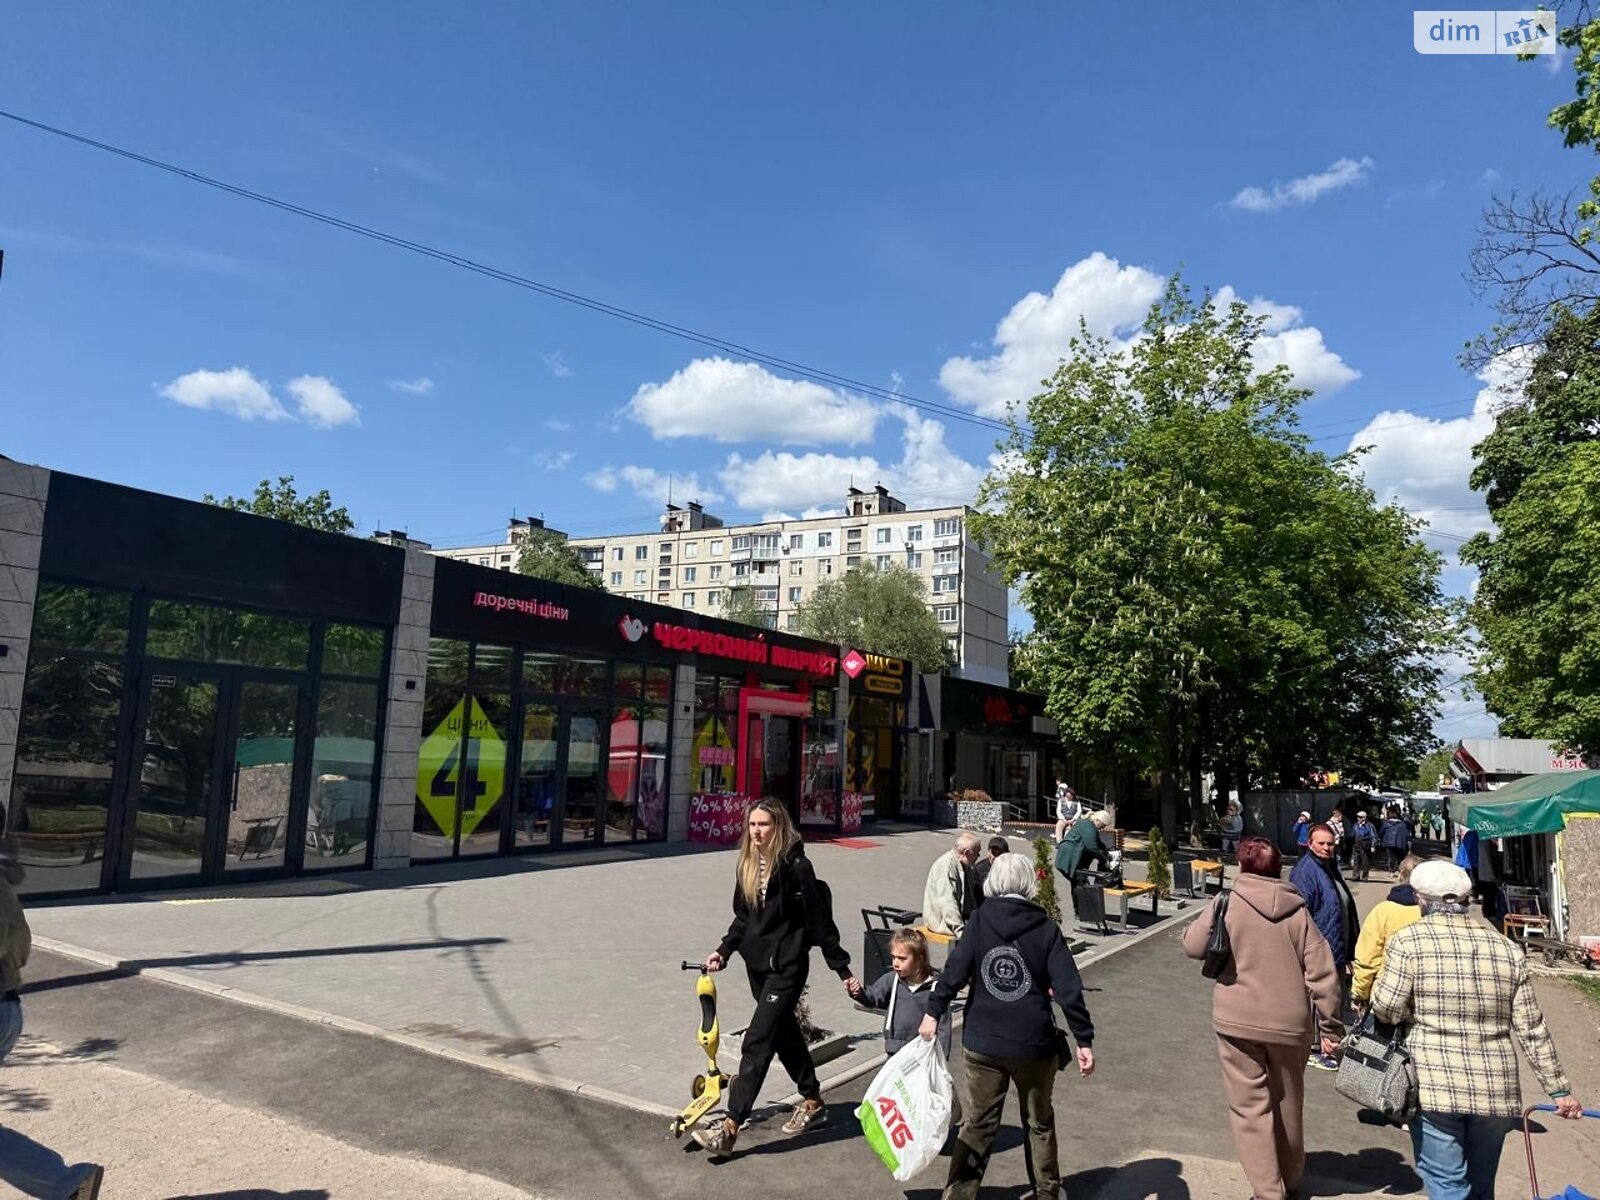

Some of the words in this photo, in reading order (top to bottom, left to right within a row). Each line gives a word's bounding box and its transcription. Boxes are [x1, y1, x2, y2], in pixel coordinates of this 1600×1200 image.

[473, 591, 538, 614] доречні
[538, 602, 570, 621] ціни
[876, 1096, 915, 1150] АТБ
